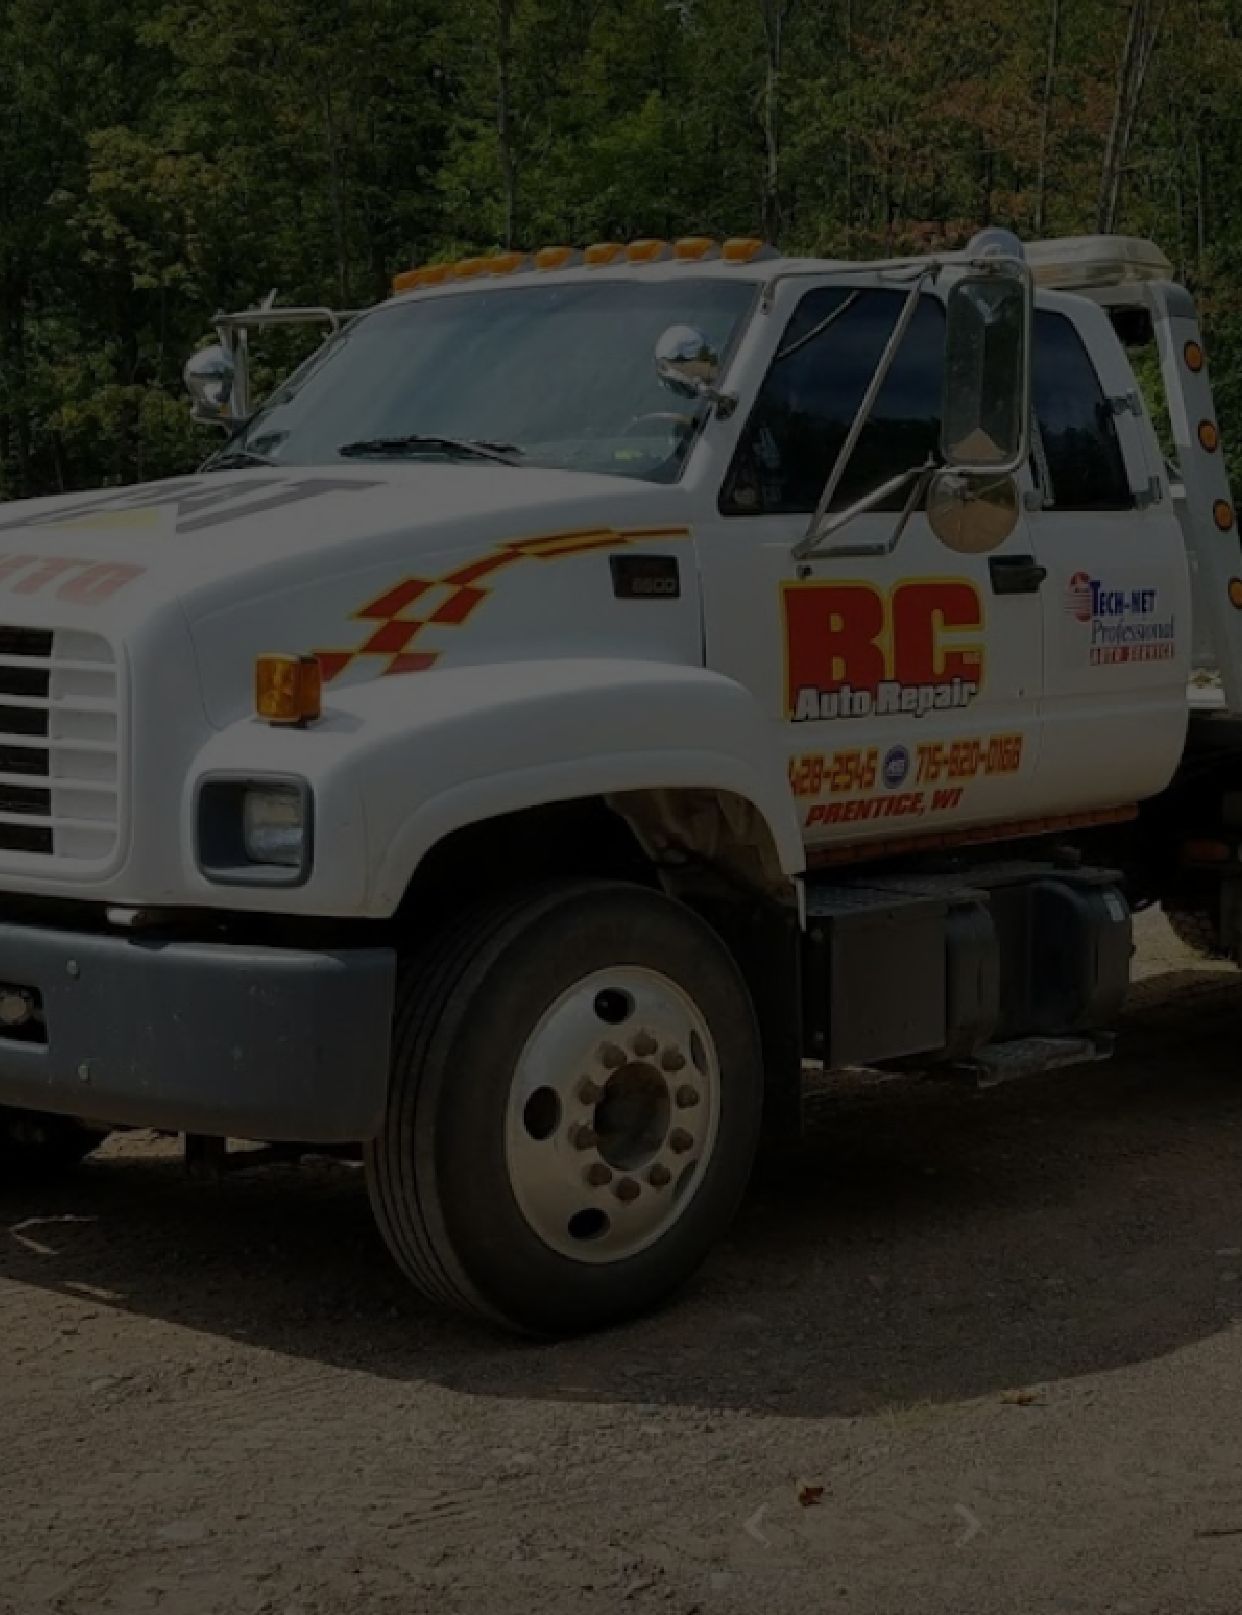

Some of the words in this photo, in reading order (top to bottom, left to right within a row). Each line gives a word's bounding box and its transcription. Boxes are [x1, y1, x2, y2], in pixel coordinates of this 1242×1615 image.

[792, 683, 873, 722] Auto
[876, 677, 978, 718] Repair
[931, 788, 964, 810] WI
